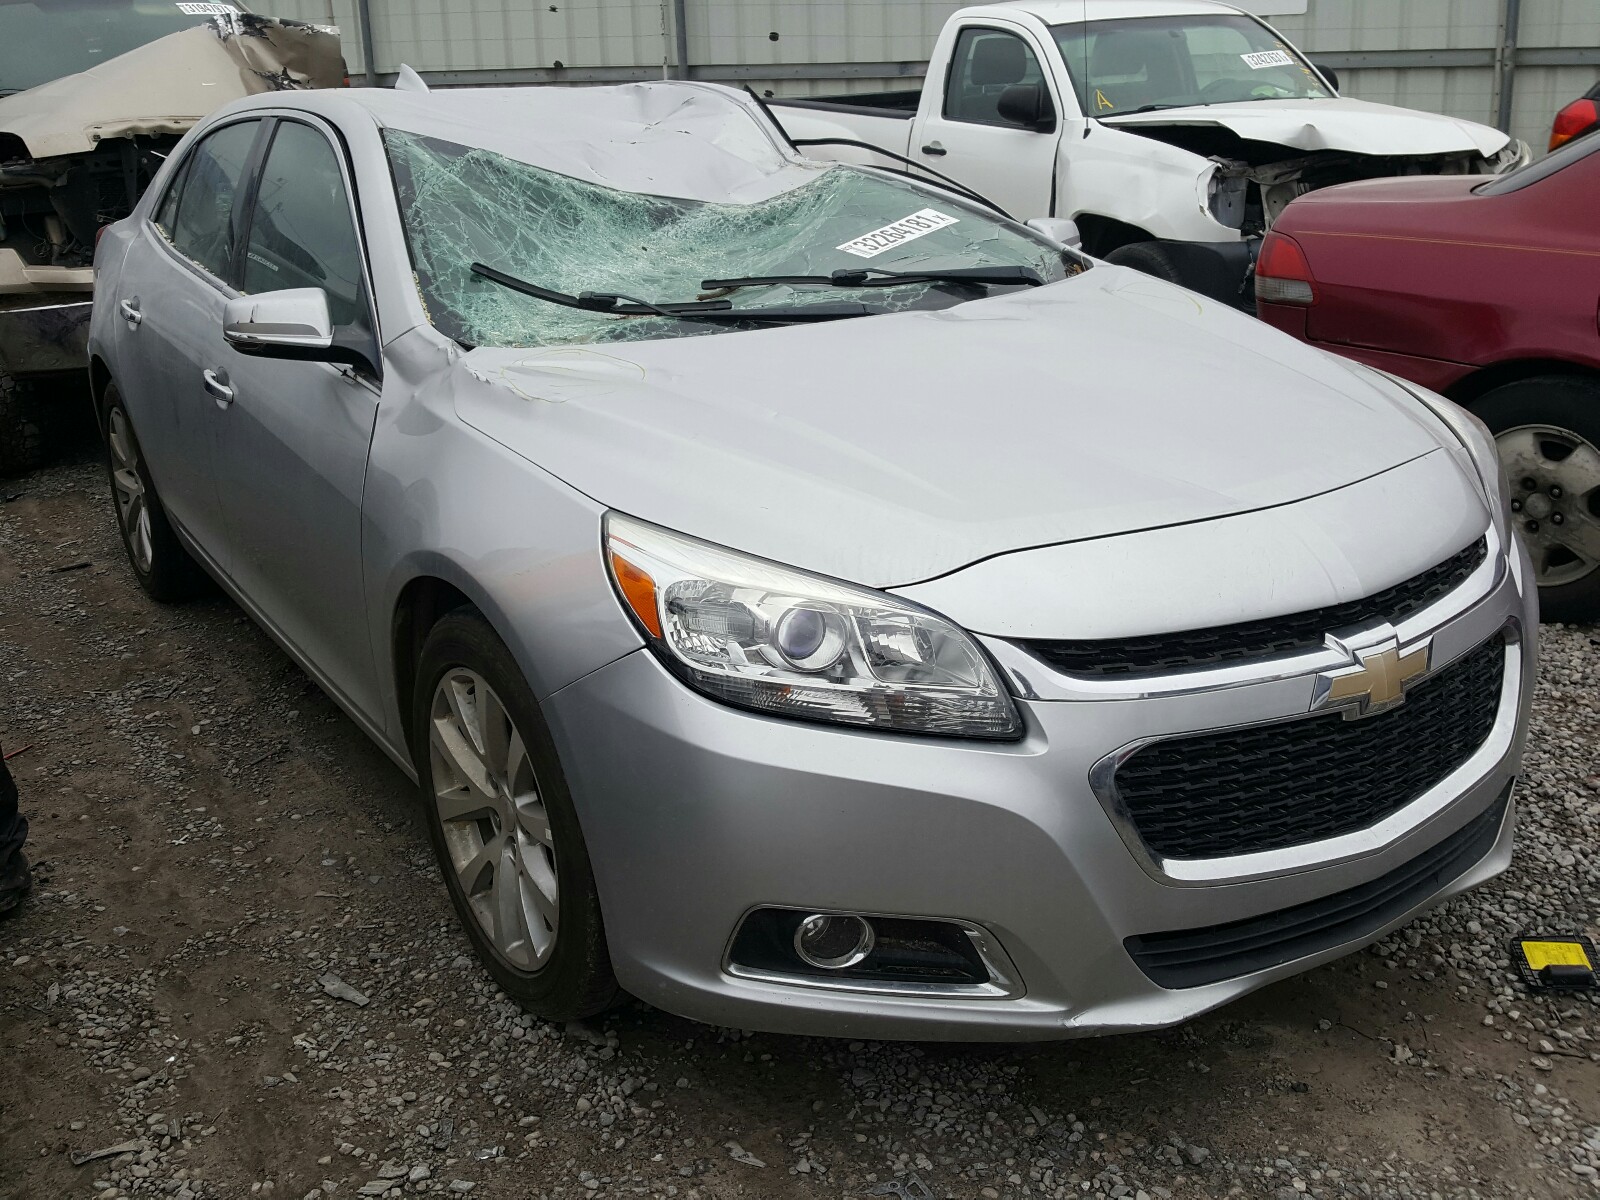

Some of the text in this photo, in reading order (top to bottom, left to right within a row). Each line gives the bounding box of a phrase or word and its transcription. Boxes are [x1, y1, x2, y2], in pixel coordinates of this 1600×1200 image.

[1247, 51, 1282, 66] 32427631
[1096, 89, 1114, 110] A
[853, 214, 941, 251] 32264181
